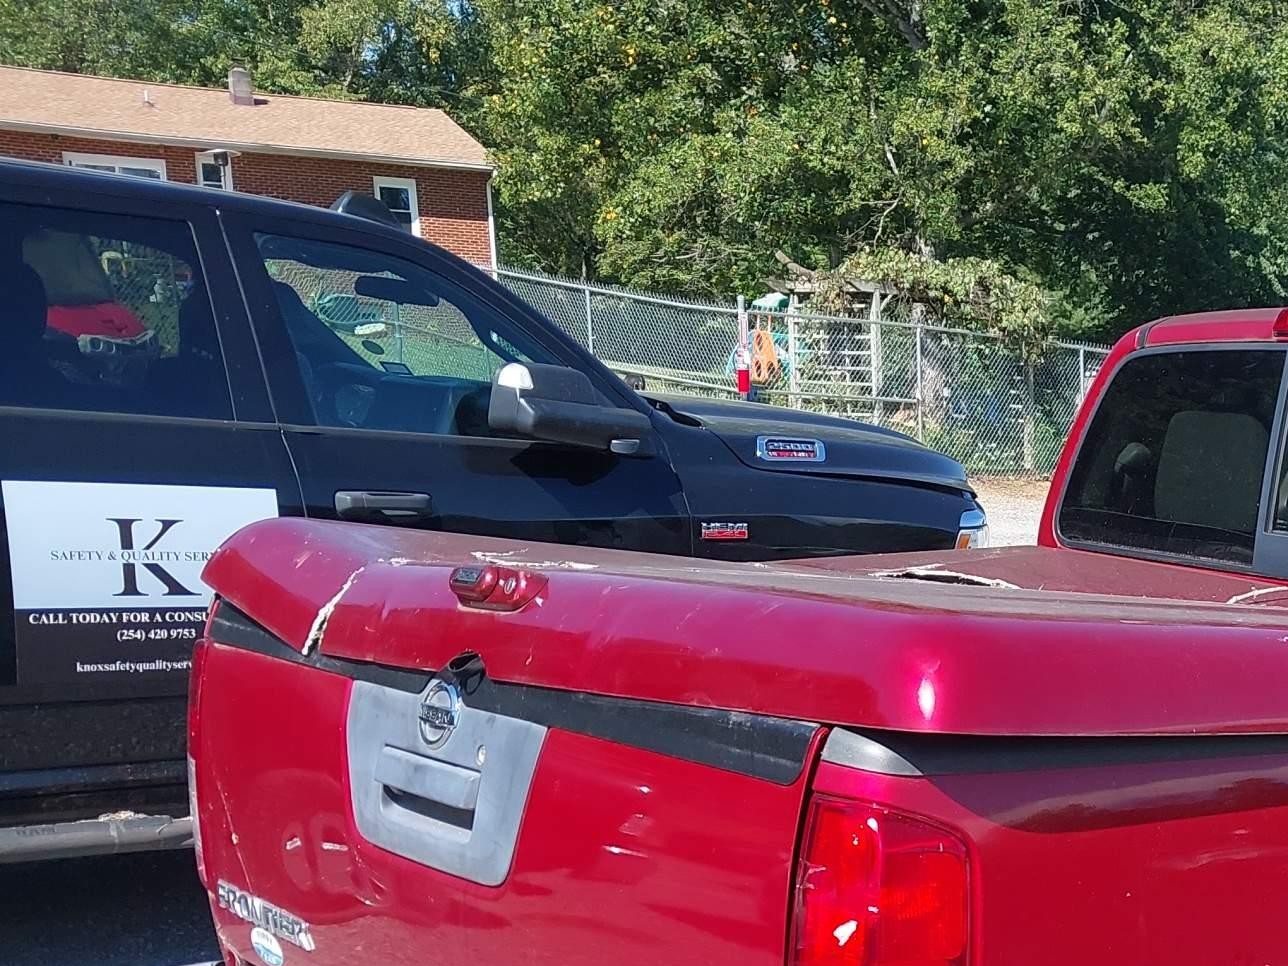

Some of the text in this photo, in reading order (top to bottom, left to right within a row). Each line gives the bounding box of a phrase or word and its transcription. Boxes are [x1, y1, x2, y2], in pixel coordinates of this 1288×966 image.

[50, 550, 103, 561] SAFETY
[107, 551, 117, 561] &
[121, 550, 182, 564] QUALITY
[105, 517, 203, 597] K
[28, 612, 68, 625] CALL
[69, 612, 123, 624] TODAY
[122, 611, 151, 623] FOR
[153, 611, 163, 623] A
[116, 628, 197, 642] (254) 420 9753
